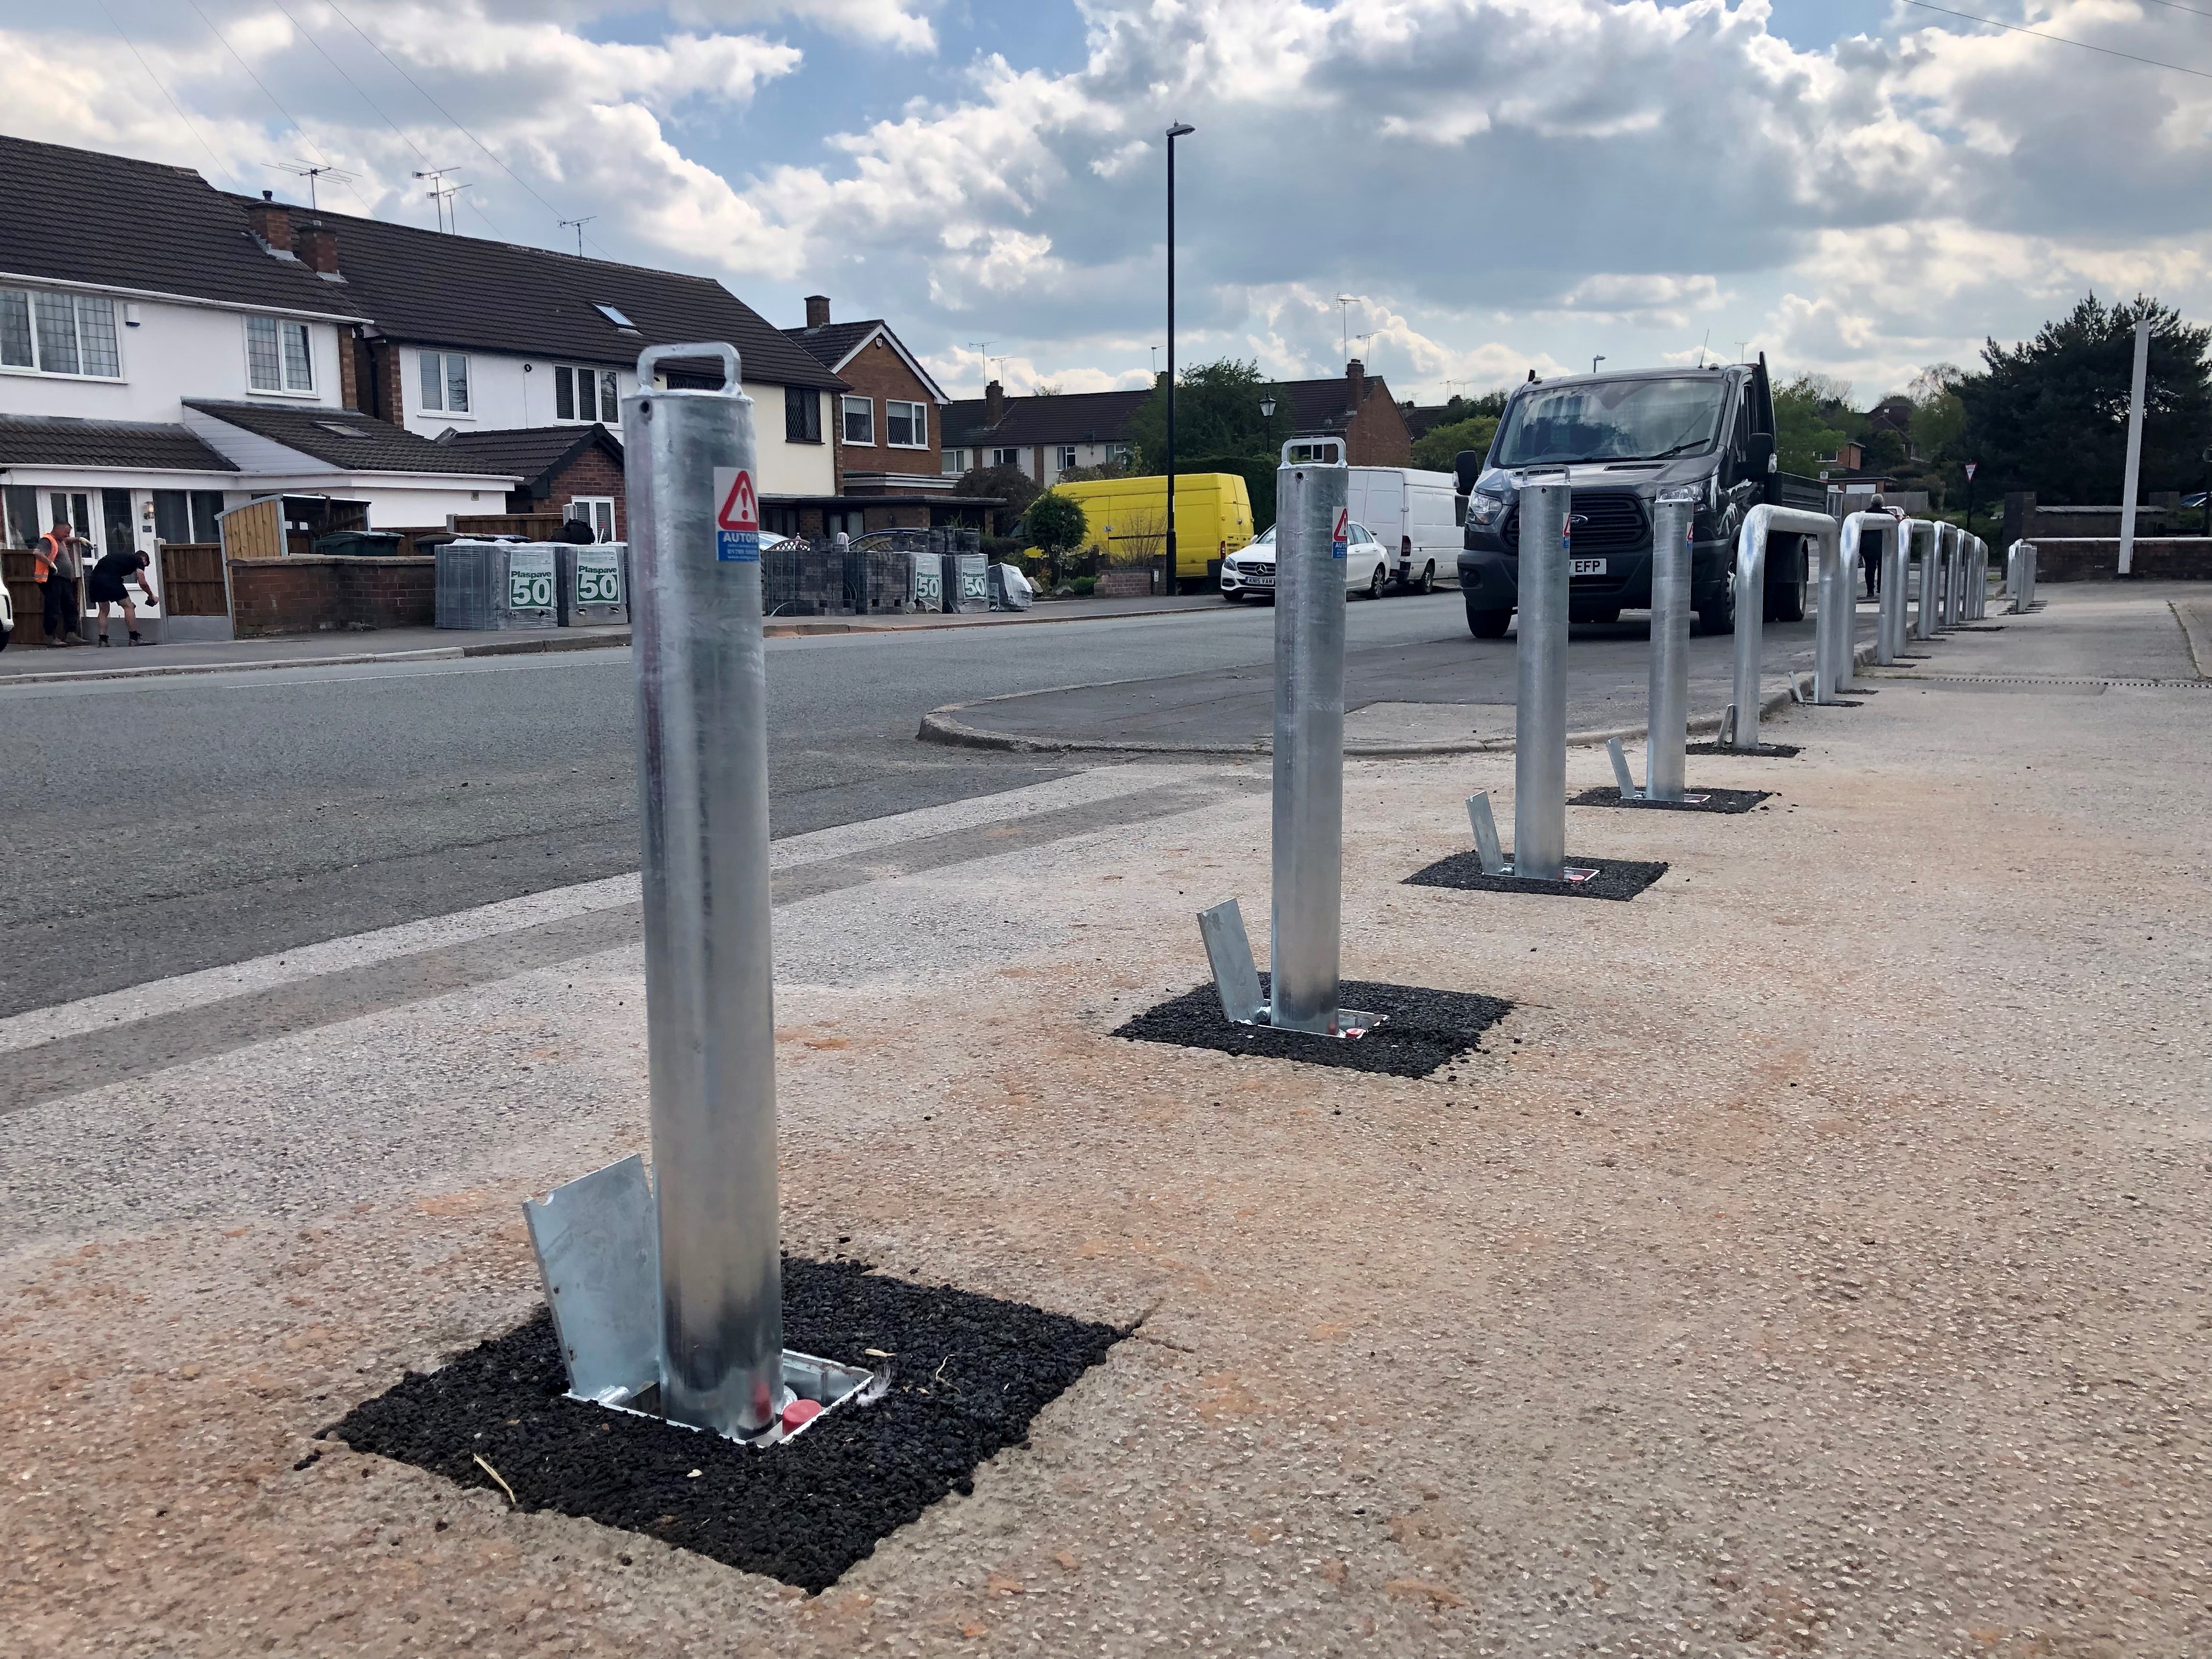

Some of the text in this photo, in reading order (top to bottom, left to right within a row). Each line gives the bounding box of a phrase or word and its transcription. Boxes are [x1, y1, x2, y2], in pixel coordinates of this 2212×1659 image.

[511, 571, 552, 579] Plaspave
[578, 565, 617, 574] Plaspave
[1575, 561, 1600, 573] EFP
[512, 578, 550, 605] 50
[579, 574, 617, 599] 50
[917, 578, 939, 597] 50
[964, 578, 985, 596] 50
